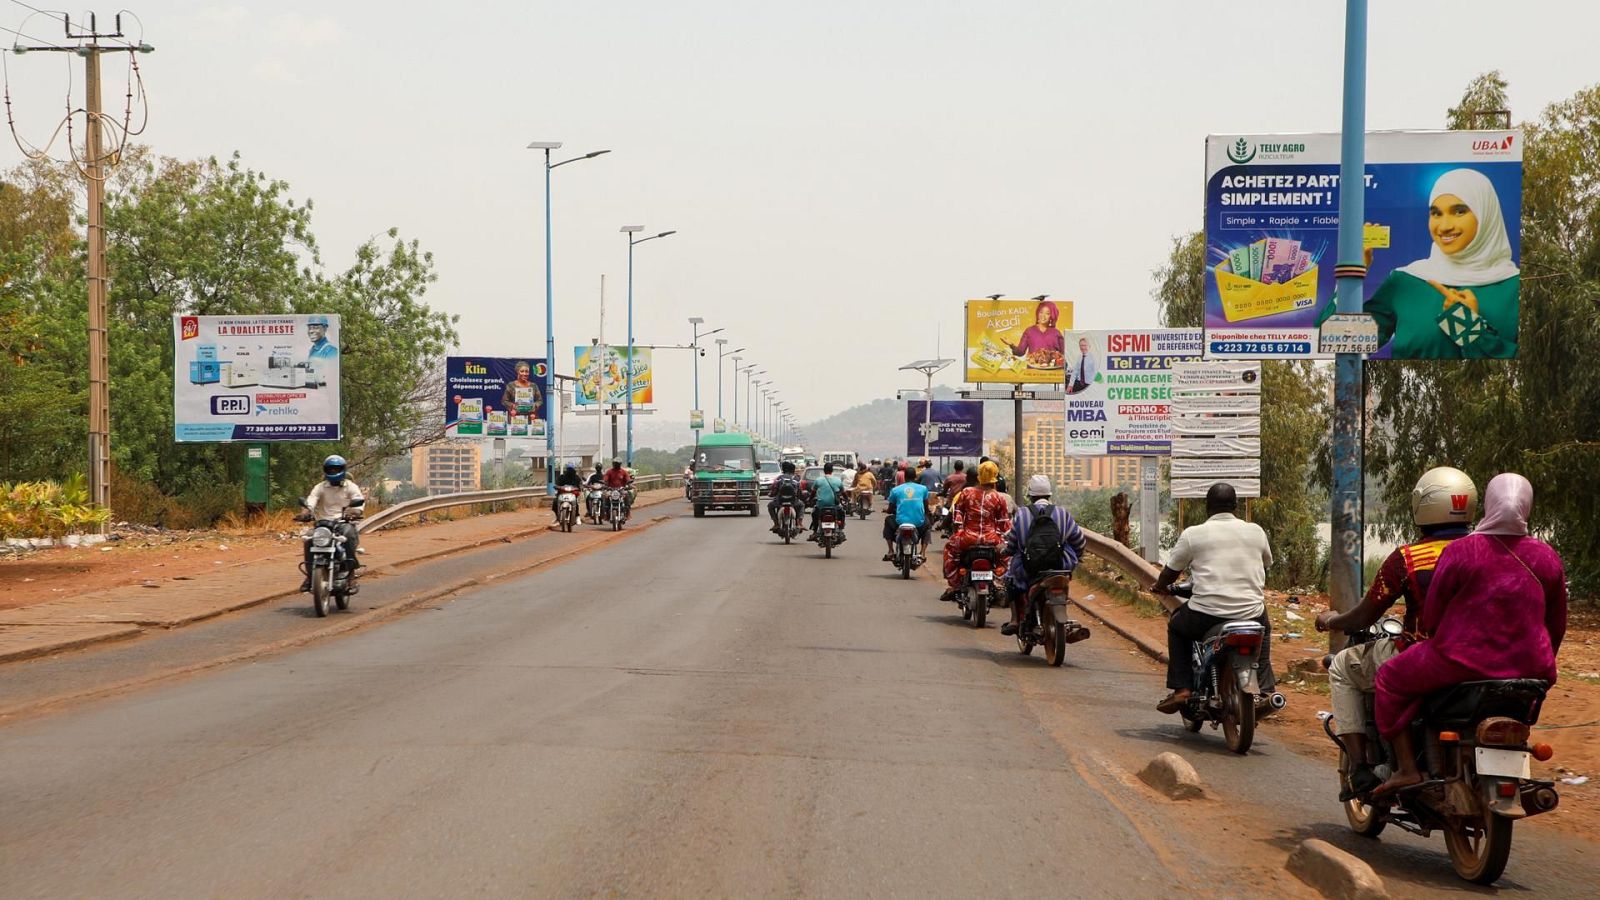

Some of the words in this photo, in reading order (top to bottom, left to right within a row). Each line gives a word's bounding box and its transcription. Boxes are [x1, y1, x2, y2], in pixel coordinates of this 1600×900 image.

[1260, 144, 1281, 152] TELLY
[1283, 144, 1305, 152] AGRO
[1472, 141, 1498, 150] UBA
[1221, 175, 1293, 188] ACHETEZ
[1297, 175, 1378, 189] PARTT,
[1221, 193, 1323, 205] SIMPLEMENT
[1326, 192, 1332, 205] !
[1226, 217, 1256, 227] Simple
[1269, 217, 1300, 227] Rapide
[1313, 217, 1339, 225] Fiable
[1296, 299, 1313, 307] VISA
[218, 326, 227, 335] LA
[268, 325, 295, 334] RESTE
[1210, 333, 1249, 341] Disponible
[1107, 334, 1150, 352] ISFMI
[1157, 343, 1166, 351] DE
[1217, 344, 1243, 352] +223
[1245, 344, 1258, 352] 72
[1292, 344, 1304, 352] 14
[1111, 357, 1132, 369] Tel
[1143, 356, 1160, 369] 72
[465, 364, 487, 374] Klin
[1107, 387, 1149, 400] CYBER
[1069, 400, 1104, 408] NOUVEAU
[1119, 405, 1157, 414] PROMO
[1067, 409, 1107, 422] MBA
[1069, 425, 1105, 439] eemi
